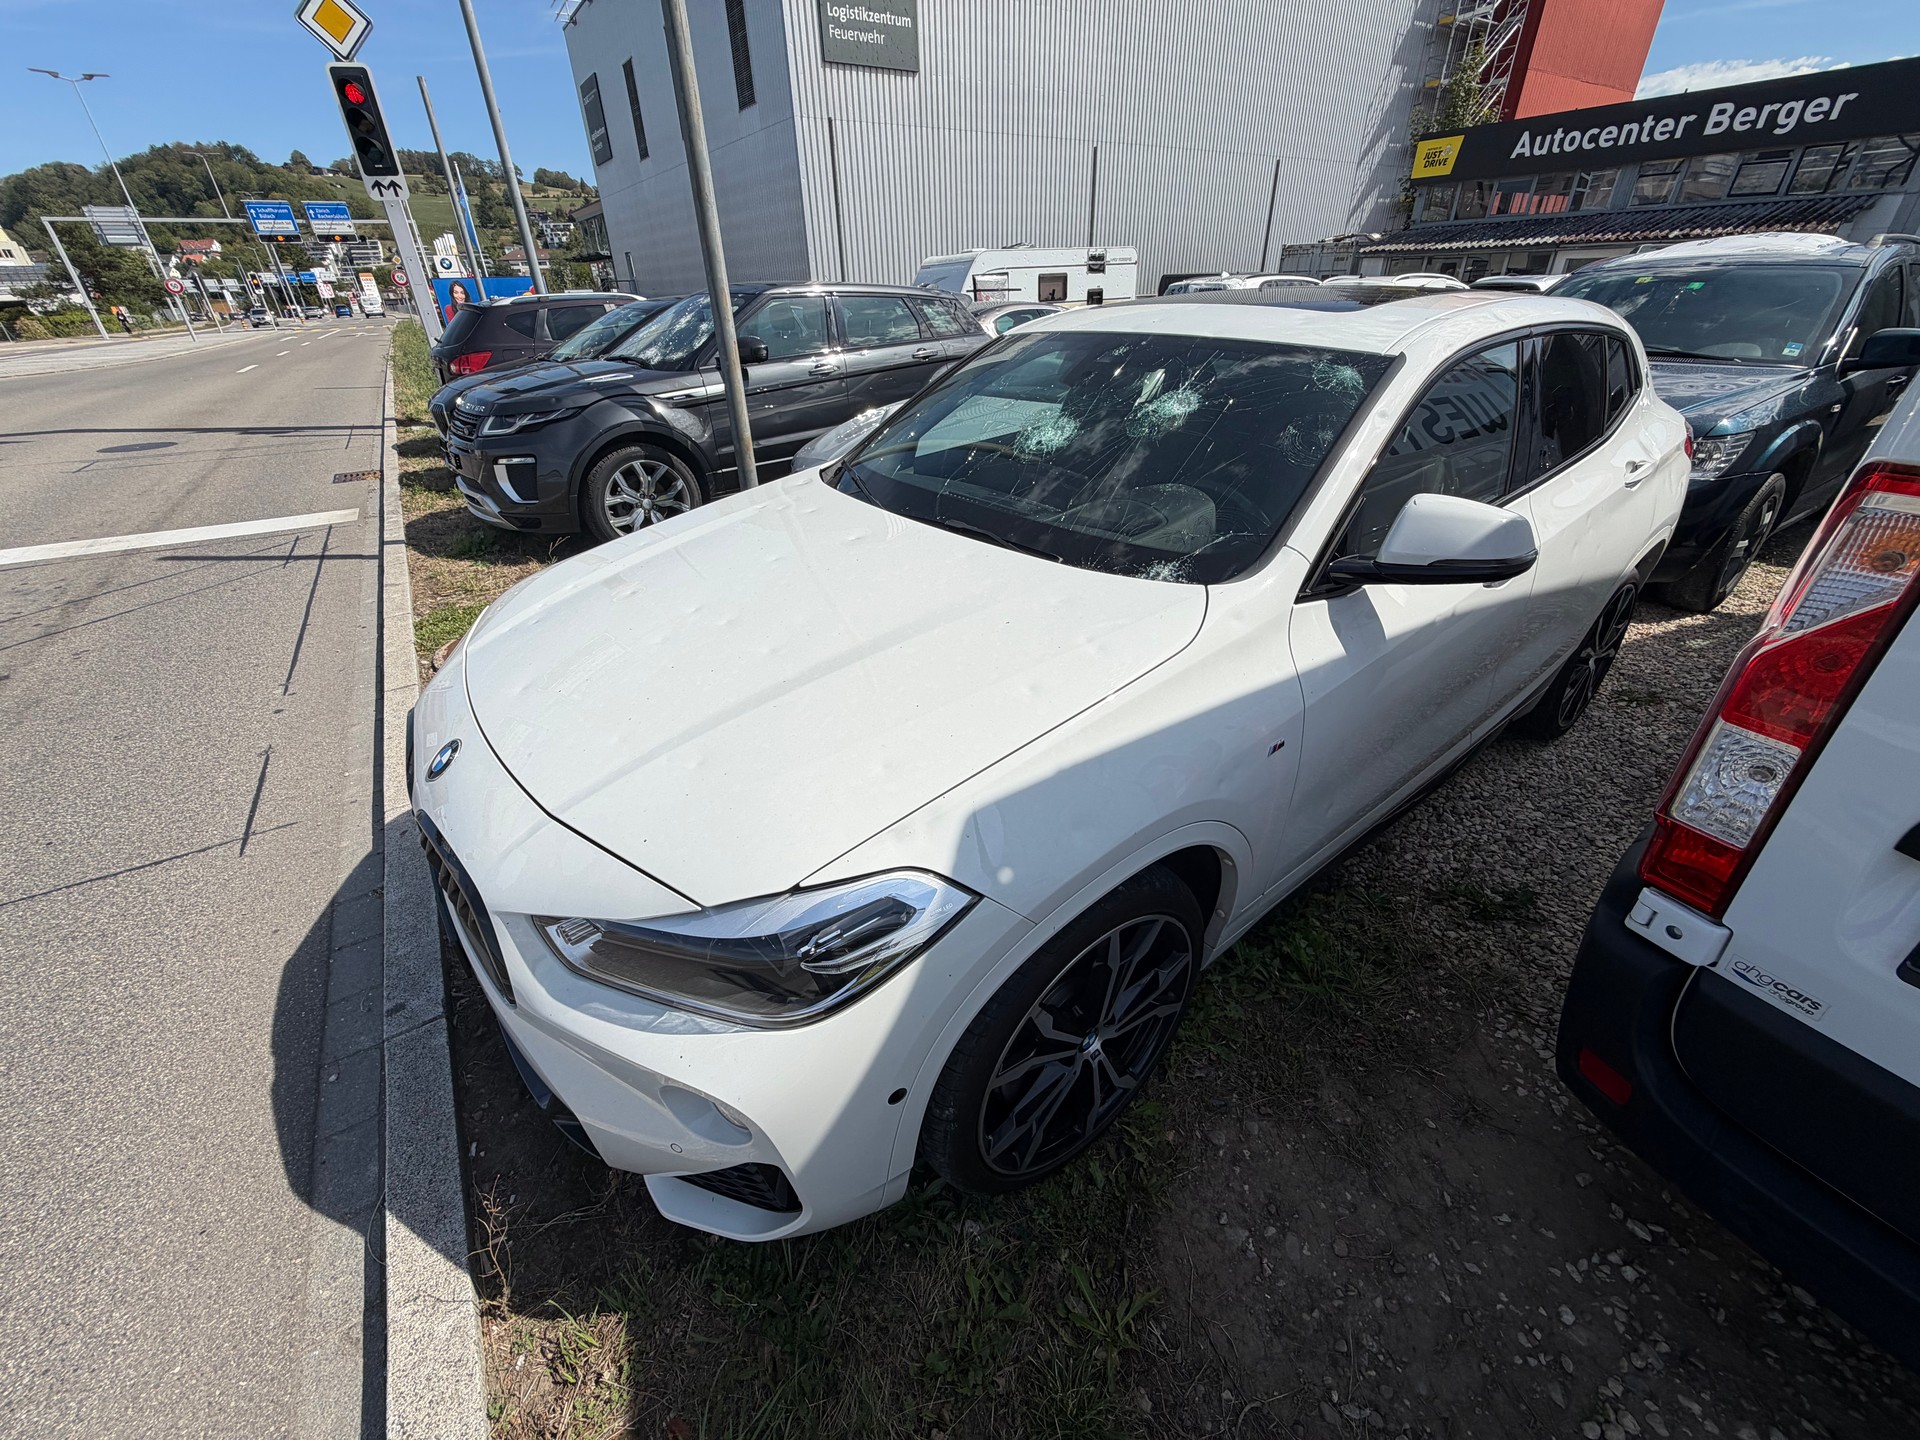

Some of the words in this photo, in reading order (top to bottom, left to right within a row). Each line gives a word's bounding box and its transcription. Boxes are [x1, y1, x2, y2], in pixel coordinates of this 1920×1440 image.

[827, 2, 911, 28] Logistikzentrum
[829, 24, 885, 45] Feuerwehr
[1510, 113, 1697, 159] Autocenter
[1703, 92, 1859, 135] Berger
[1423, 150, 1443, 160] JUST
[1424, 158, 1449, 168] DRIVE
[396, 274, 405, 282] 50
